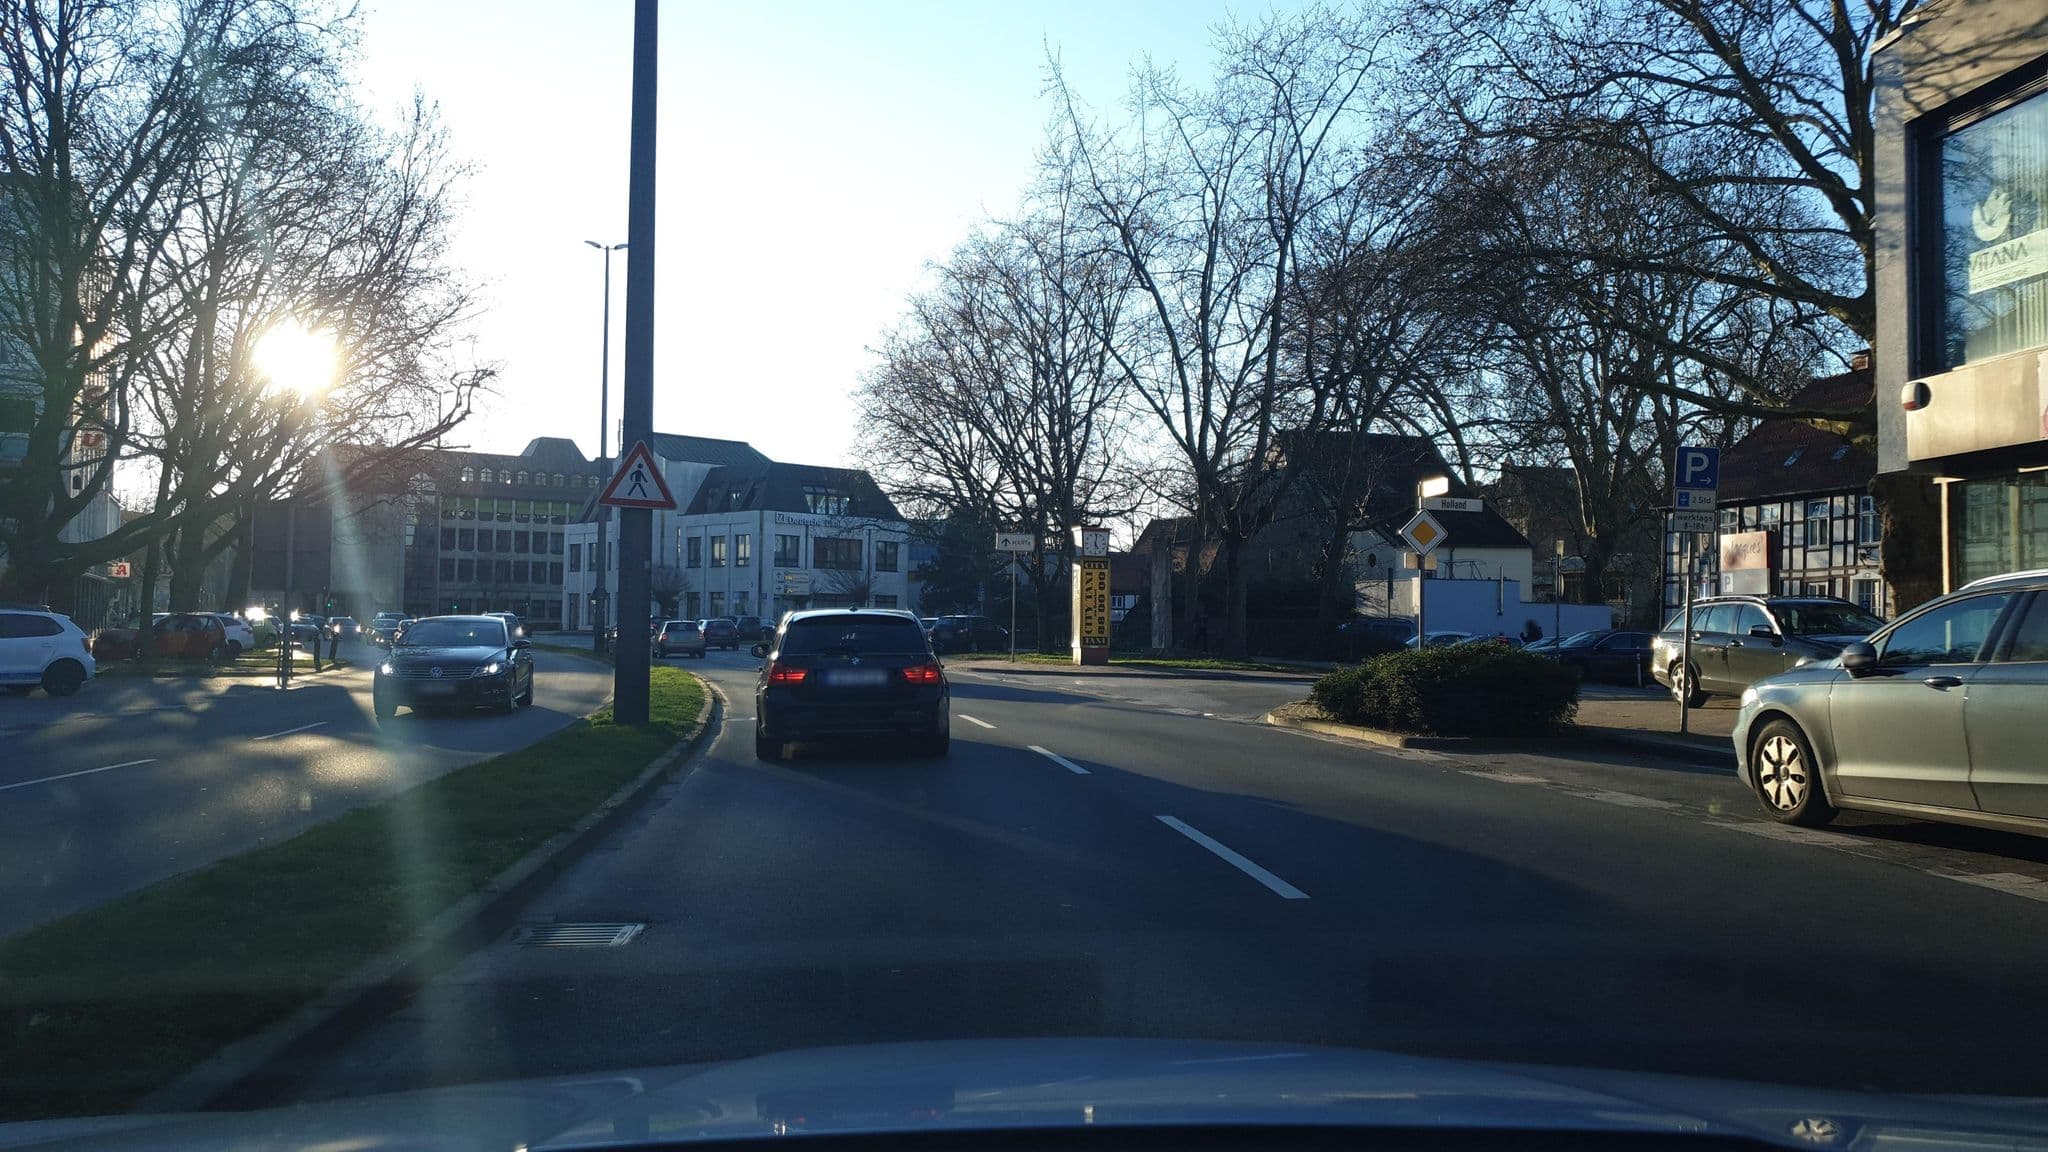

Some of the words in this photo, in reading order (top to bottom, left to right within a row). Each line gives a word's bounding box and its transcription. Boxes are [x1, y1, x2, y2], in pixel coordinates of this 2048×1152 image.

[1441, 499, 1467, 510] Holland
[1677, 514, 1713, 523] werktags
[1084, 561, 1106, 569] CITY
[1084, 571, 1093, 601] TAXI
[1084, 606, 1093, 634] CITY
[1083, 637, 1107, 645] TAXI
